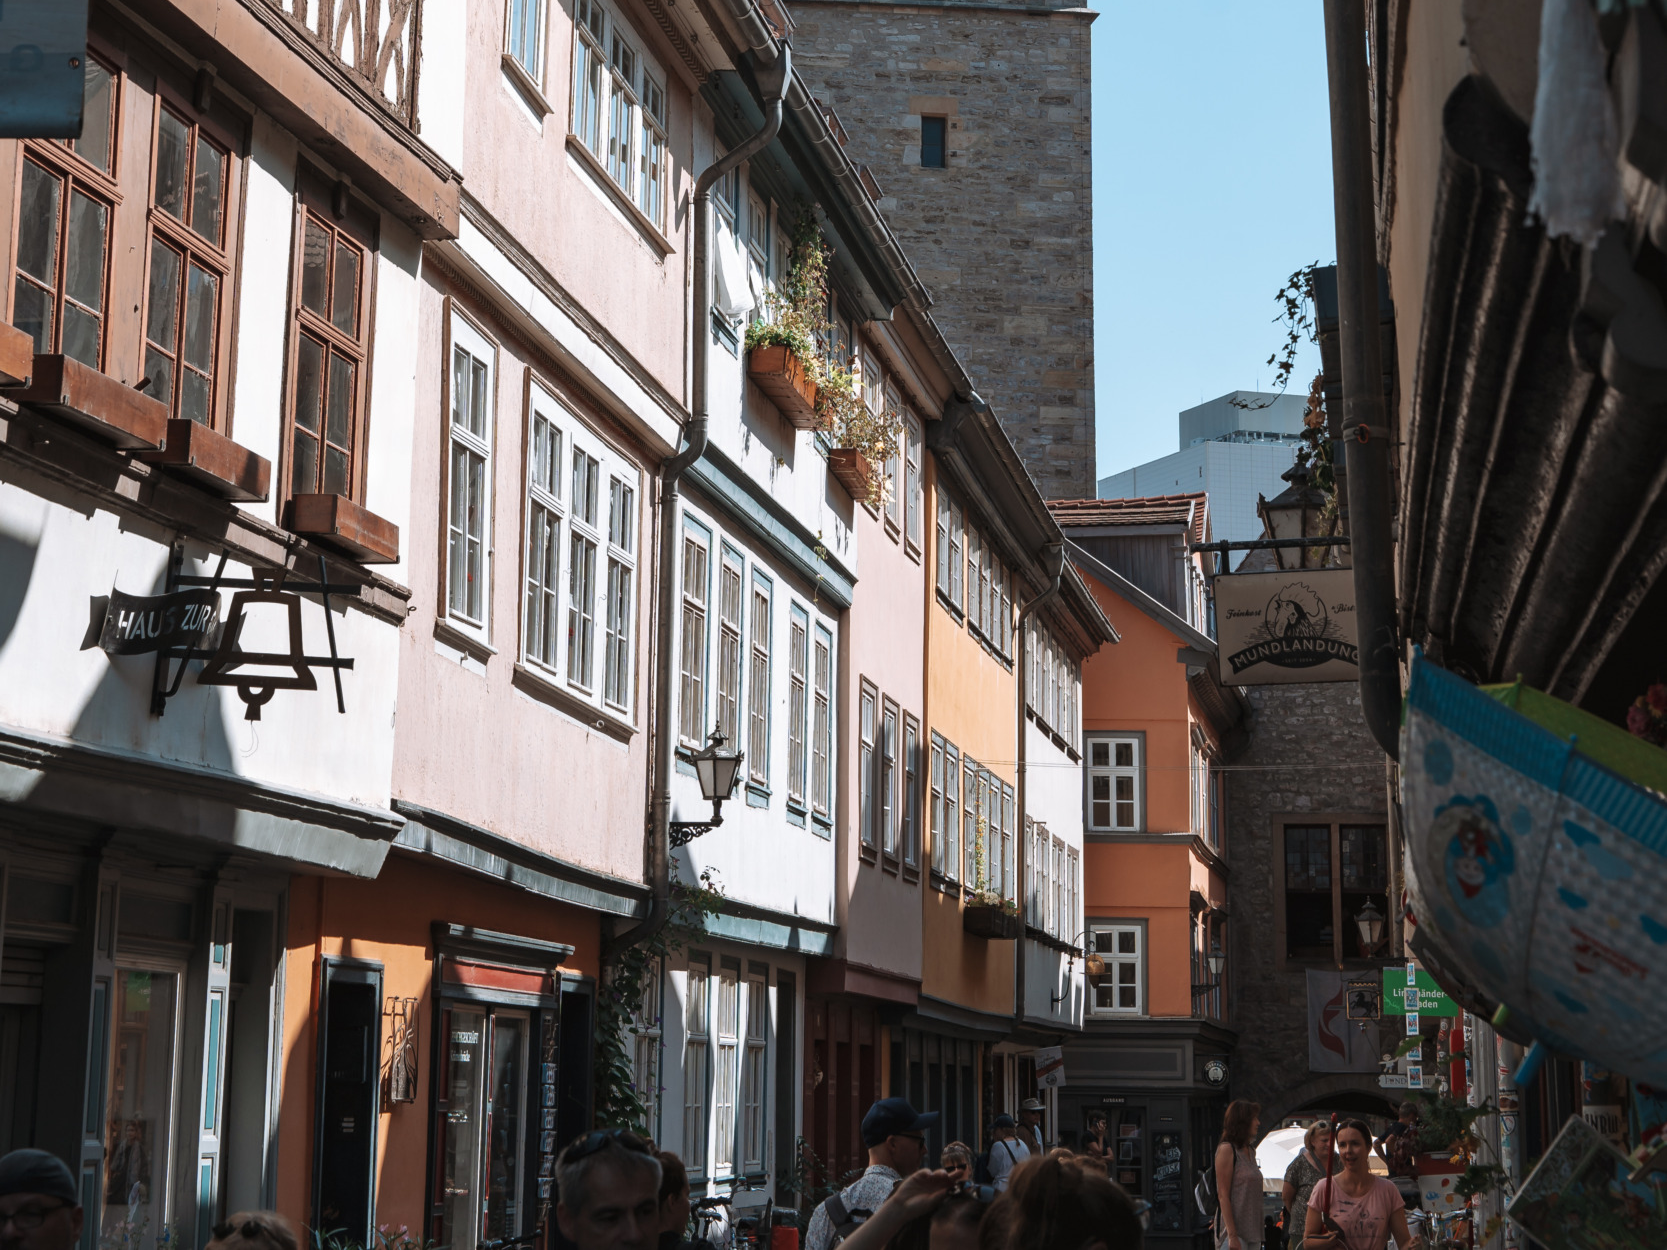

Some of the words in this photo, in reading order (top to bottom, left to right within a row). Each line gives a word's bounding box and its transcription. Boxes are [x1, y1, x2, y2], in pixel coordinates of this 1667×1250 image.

[1226, 608, 1262, 619] Feinkost
[1333, 603, 1356, 614] Bist
[116, 607, 178, 640] HAUS
[181, 604, 212, 633] ZUR
[1234, 639, 1359, 668] MUNDLANDUNG
[1419, 999, 1438, 1008] aden
[1157, 1162, 1180, 1177] KIOSK
